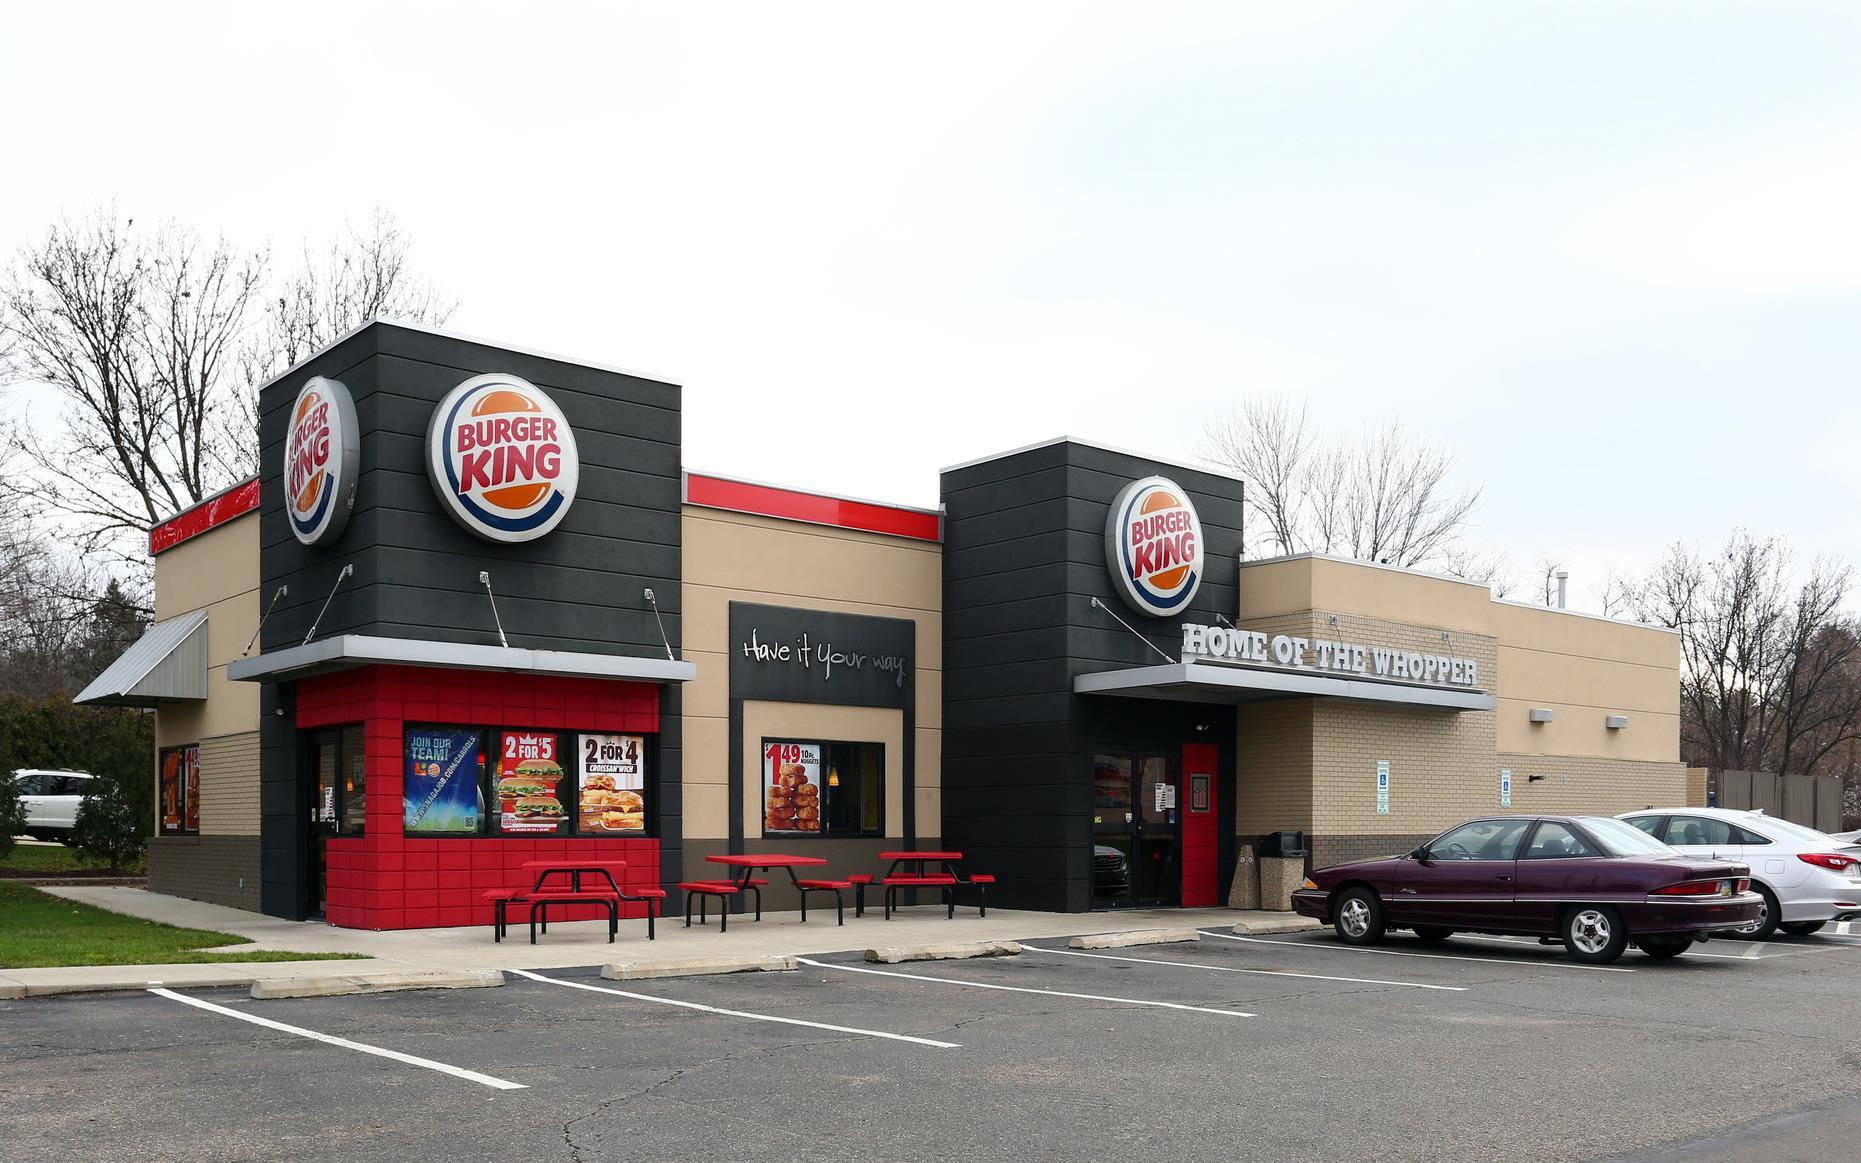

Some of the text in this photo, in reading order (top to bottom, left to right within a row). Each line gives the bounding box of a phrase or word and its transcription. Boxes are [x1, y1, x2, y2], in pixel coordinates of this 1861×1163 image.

[458, 417, 558, 453] BURGER
[288, 427, 330, 510] KING
[460, 443, 561, 493] KING
[1132, 511, 1192, 546] BURGER
[1134, 532, 1195, 579] KING
[743, 628, 790, 662] Have
[797, 632, 811, 668] it
[1182, 623, 1478, 685] HOME OF THE WHOPPER
[411, 736, 452, 749] JOIN OUR
[411, 747, 449, 761] TEAM!
[505, 736, 517, 758] 2
[518, 745, 539, 759] FOR
[585, 739, 598, 763] 2
[600, 745, 624, 760] FOR
[801, 750, 809, 759] 10
